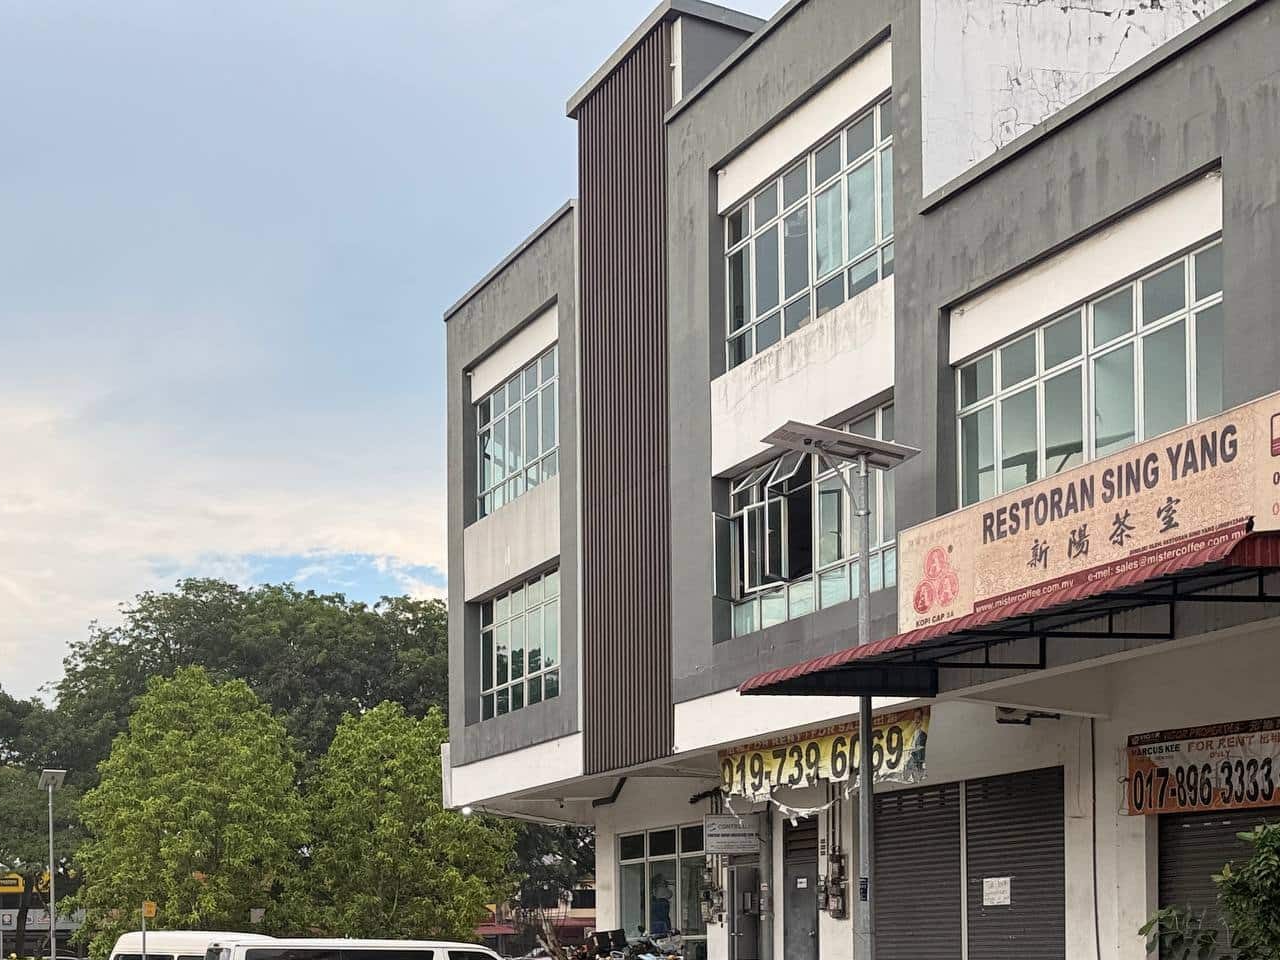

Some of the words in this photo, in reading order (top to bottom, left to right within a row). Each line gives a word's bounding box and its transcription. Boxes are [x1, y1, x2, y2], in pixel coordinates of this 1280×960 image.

[982, 475, 1095, 545] RESTORAN
[1101, 452, 1159, 504] SING
[1166, 424, 1238, 481] YANG
[916, 618, 931, 628] KOPI
[932, 613, 945, 623] CAP
[1131, 745, 1164, 756] MARCUS
[1165, 743, 1181, 753] KEE
[1187, 739, 1213, 753] FOR
[1217, 734, 1255, 749] RENT
[1133, 763, 1212, 812] 017-896
[1220, 757, 1274, 804] 3333
